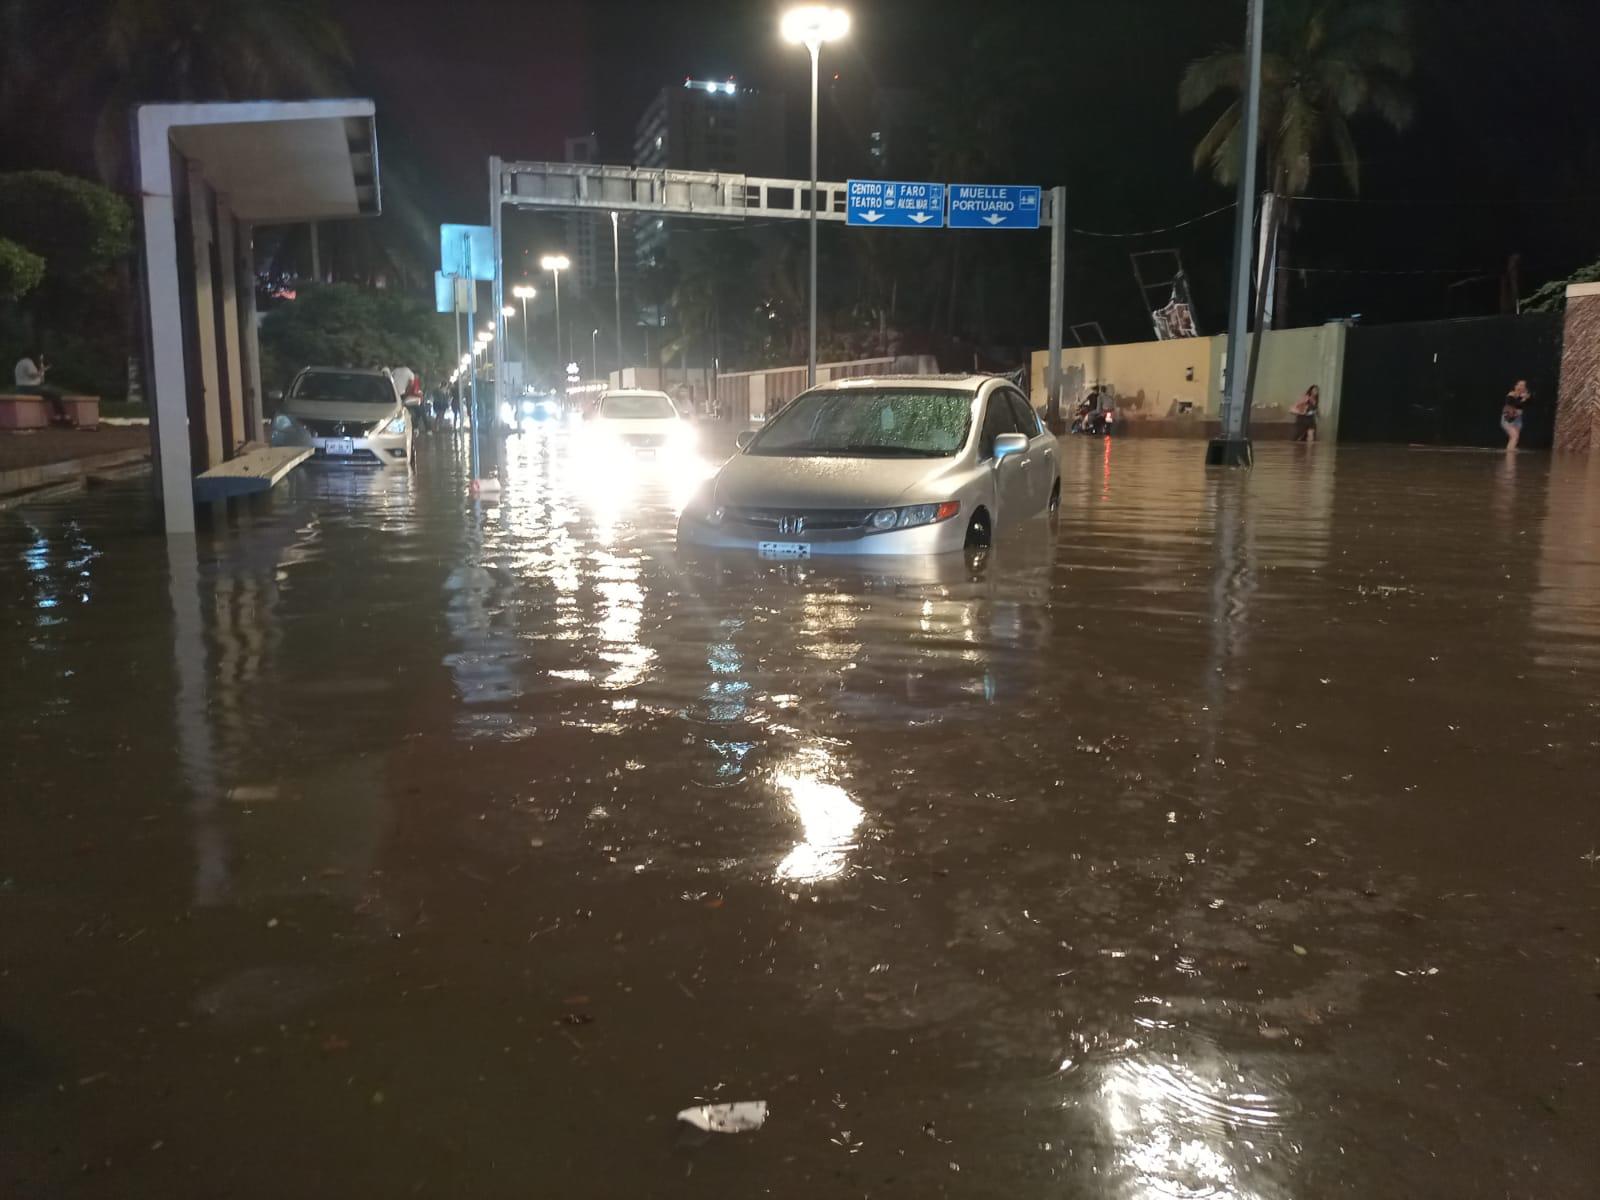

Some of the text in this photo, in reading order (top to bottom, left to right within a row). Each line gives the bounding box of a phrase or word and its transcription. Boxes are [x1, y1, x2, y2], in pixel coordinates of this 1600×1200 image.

[851, 183, 882, 195] CENTRO
[900, 185, 926, 196] FARO
[960, 187, 1007, 199] MUELLE
[851, 196, 882, 209] TEATRO
[952, 200, 1015, 211] PORTUARIO
